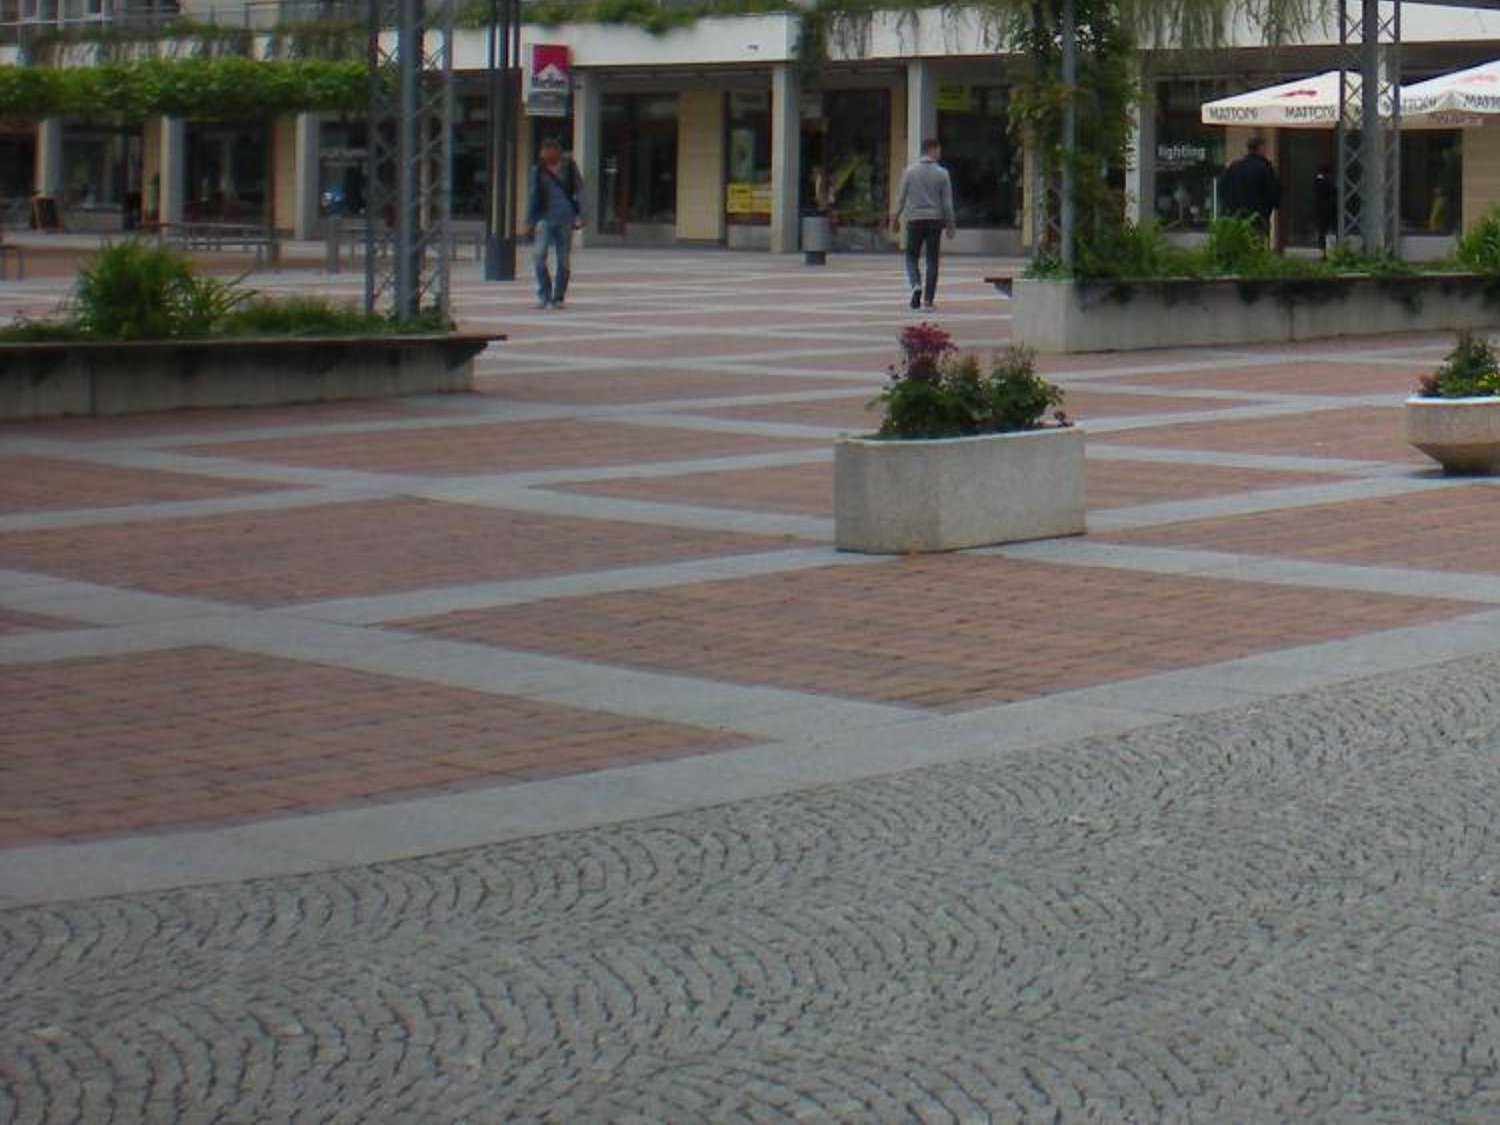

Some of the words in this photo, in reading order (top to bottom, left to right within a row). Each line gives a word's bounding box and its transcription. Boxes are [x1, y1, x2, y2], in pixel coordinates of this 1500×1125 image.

[1209, 106, 1258, 120] MATTONI
[1285, 106, 1336, 120] MATTONI
[1157, 144, 1206, 162] lighting
